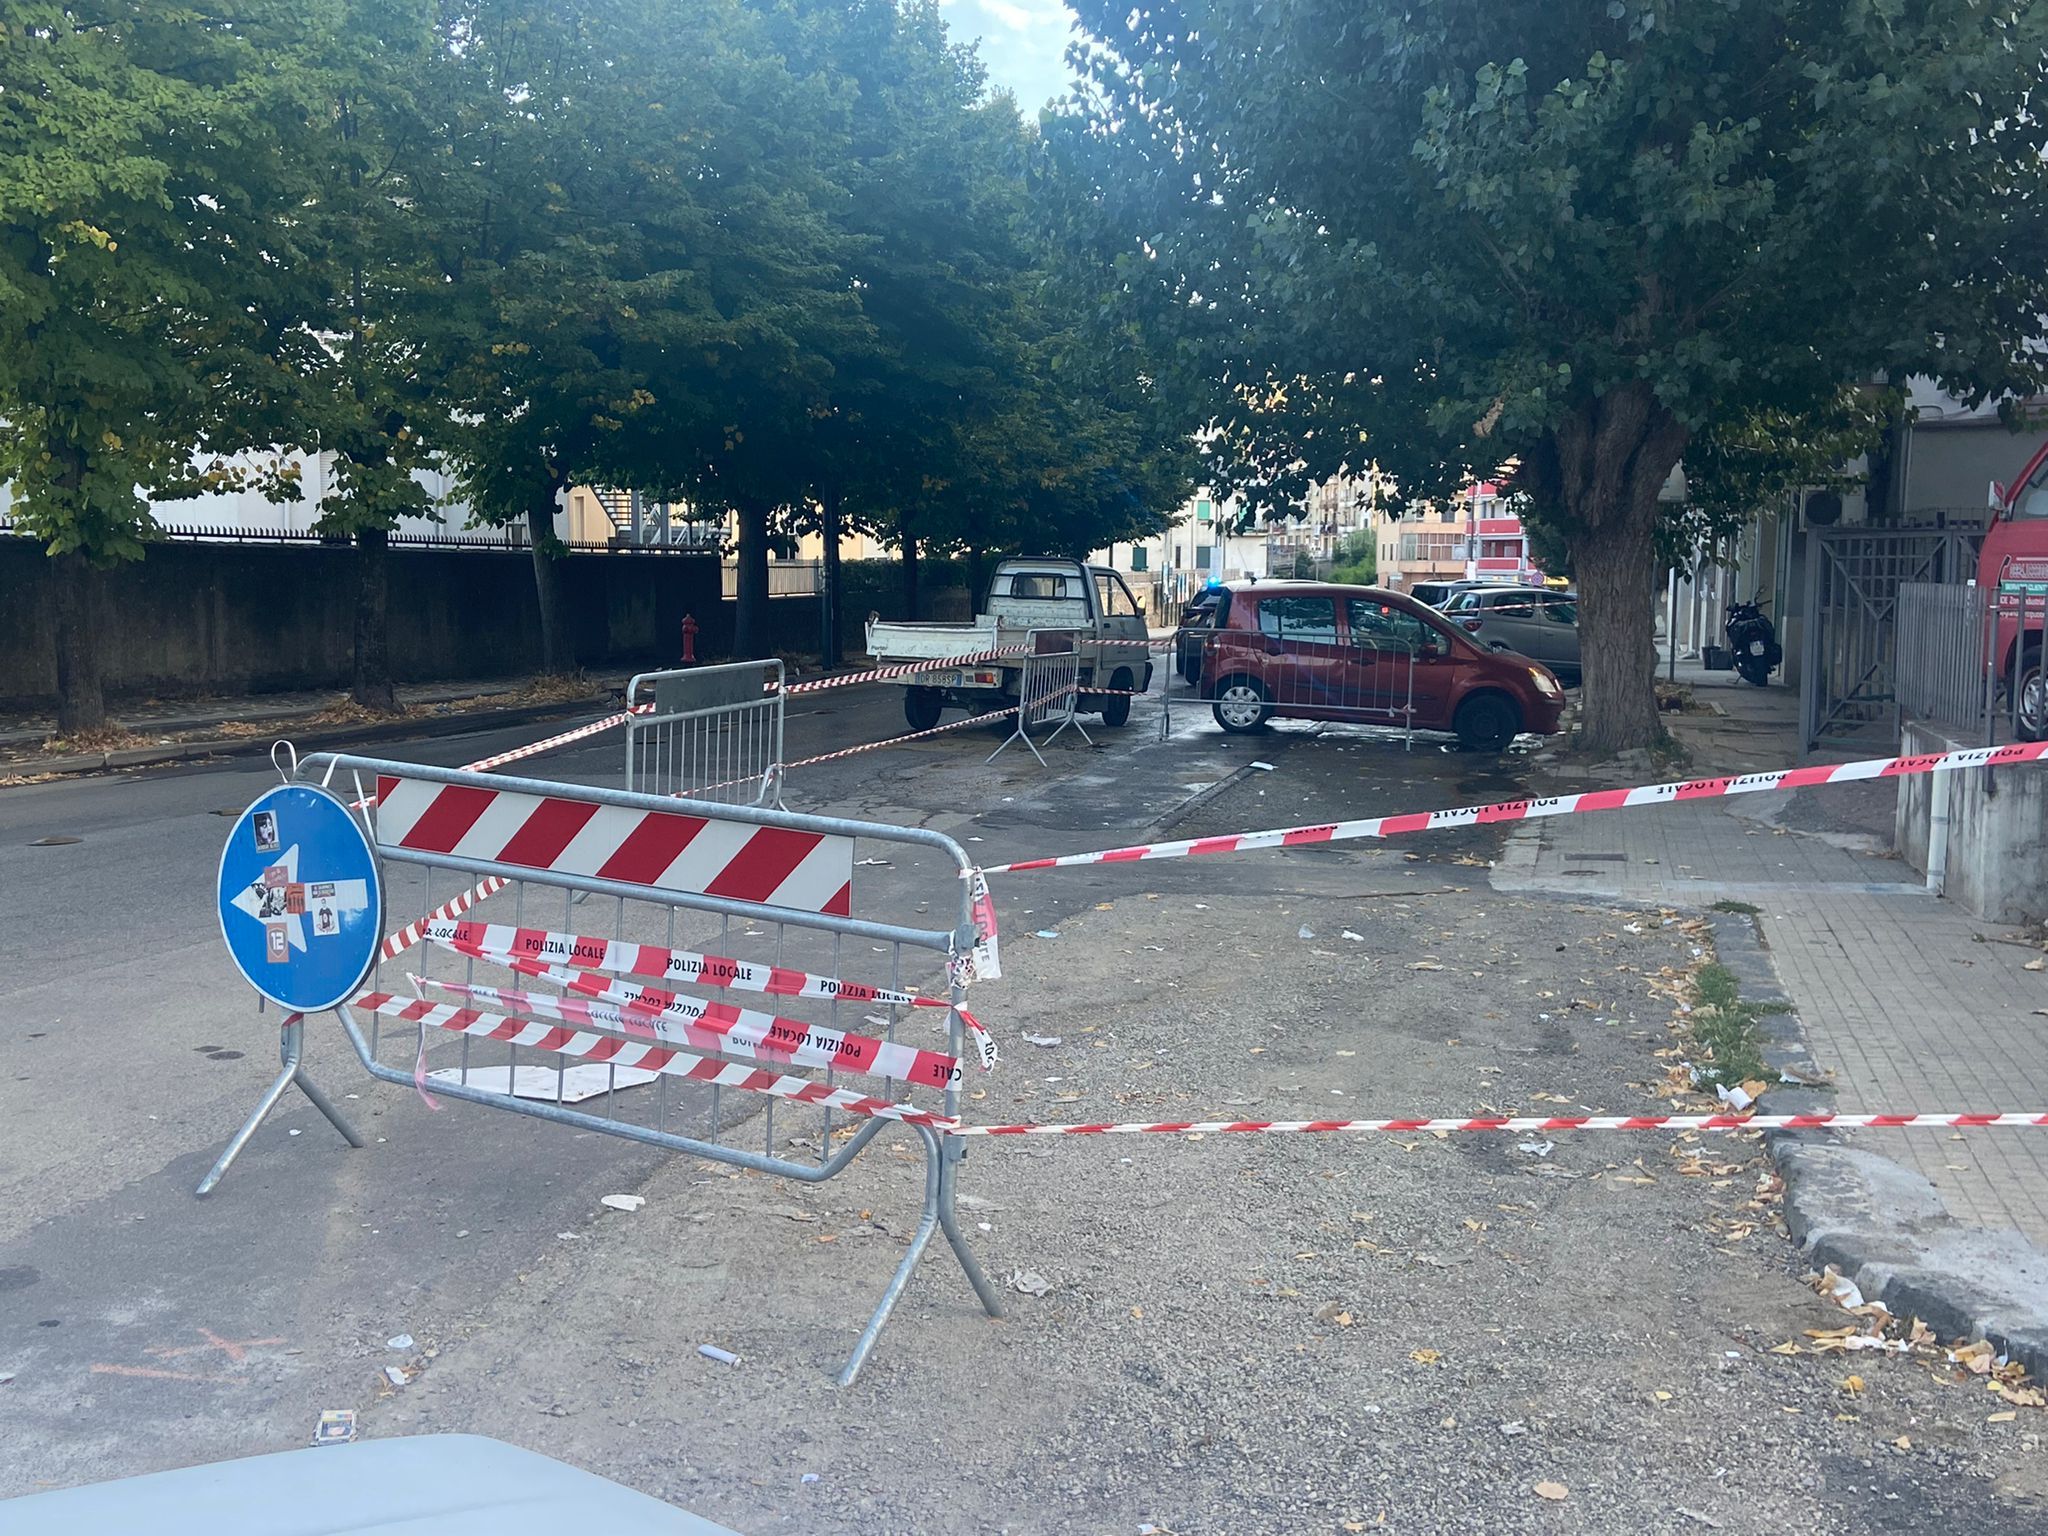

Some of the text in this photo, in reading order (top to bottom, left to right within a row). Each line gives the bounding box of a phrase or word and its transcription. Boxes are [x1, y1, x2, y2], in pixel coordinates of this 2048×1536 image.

[271, 932, 284, 950] 12
[526, 938, 605, 960] POLIZIA LOCALE
[666, 957, 752, 981] POLIZIA LOCALE
[820, 980, 867, 999] POLIZIA
[664, 1002, 707, 1020] POLIZIA
[769, 1025, 811, 1047] LOCALE
[815, 1035, 862, 1059] POLIZIA
[933, 1063, 963, 1082] CALE
